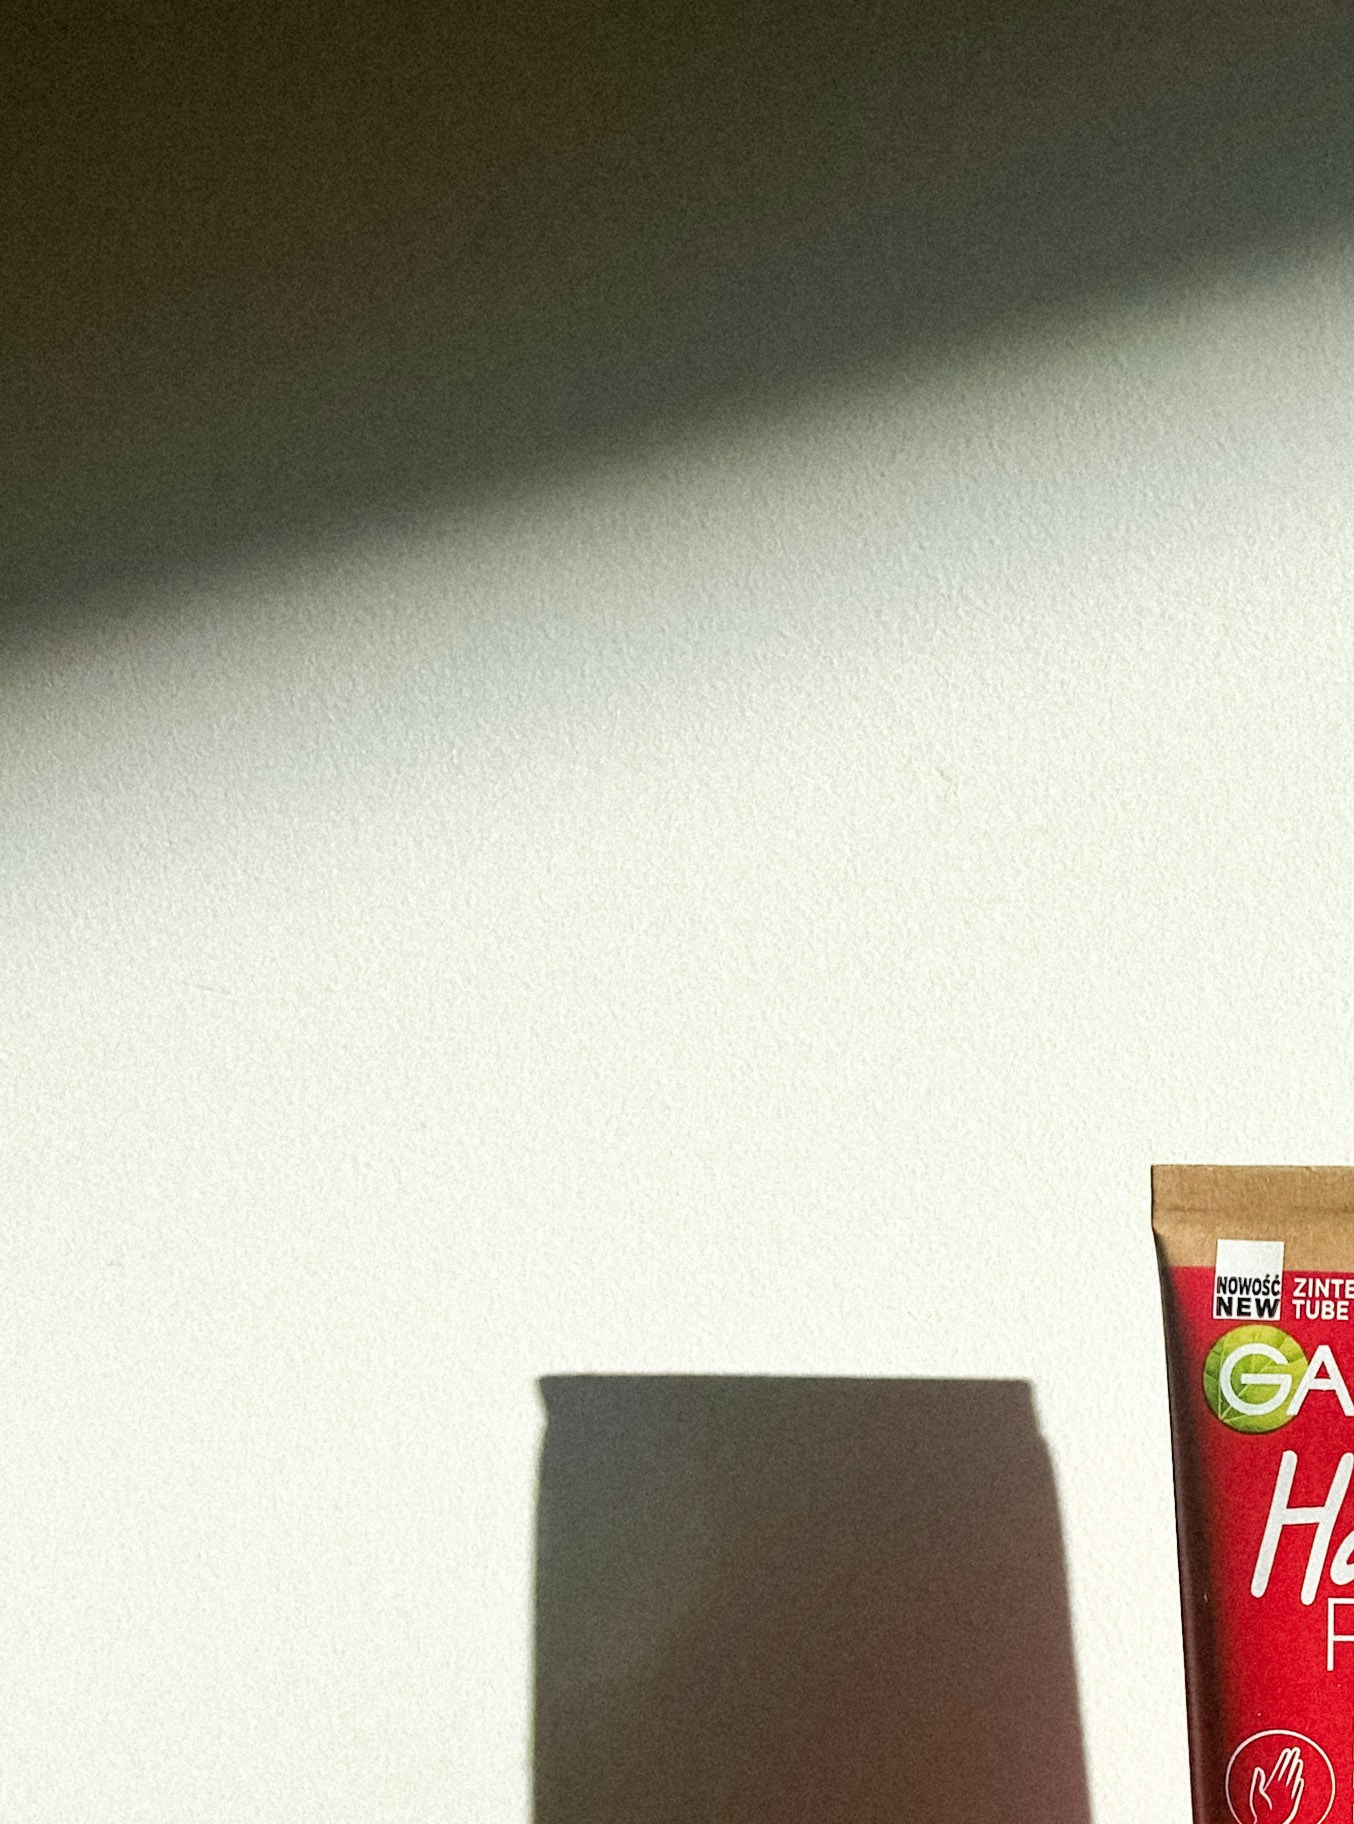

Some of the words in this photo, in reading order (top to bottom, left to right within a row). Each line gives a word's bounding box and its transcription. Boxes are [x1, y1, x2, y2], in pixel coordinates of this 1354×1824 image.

[1216, 1274, 1281, 1297] NOWOŚĆ
[1215, 1296, 1280, 1318] NEW
[1293, 1299, 1349, 1321] TUBE
